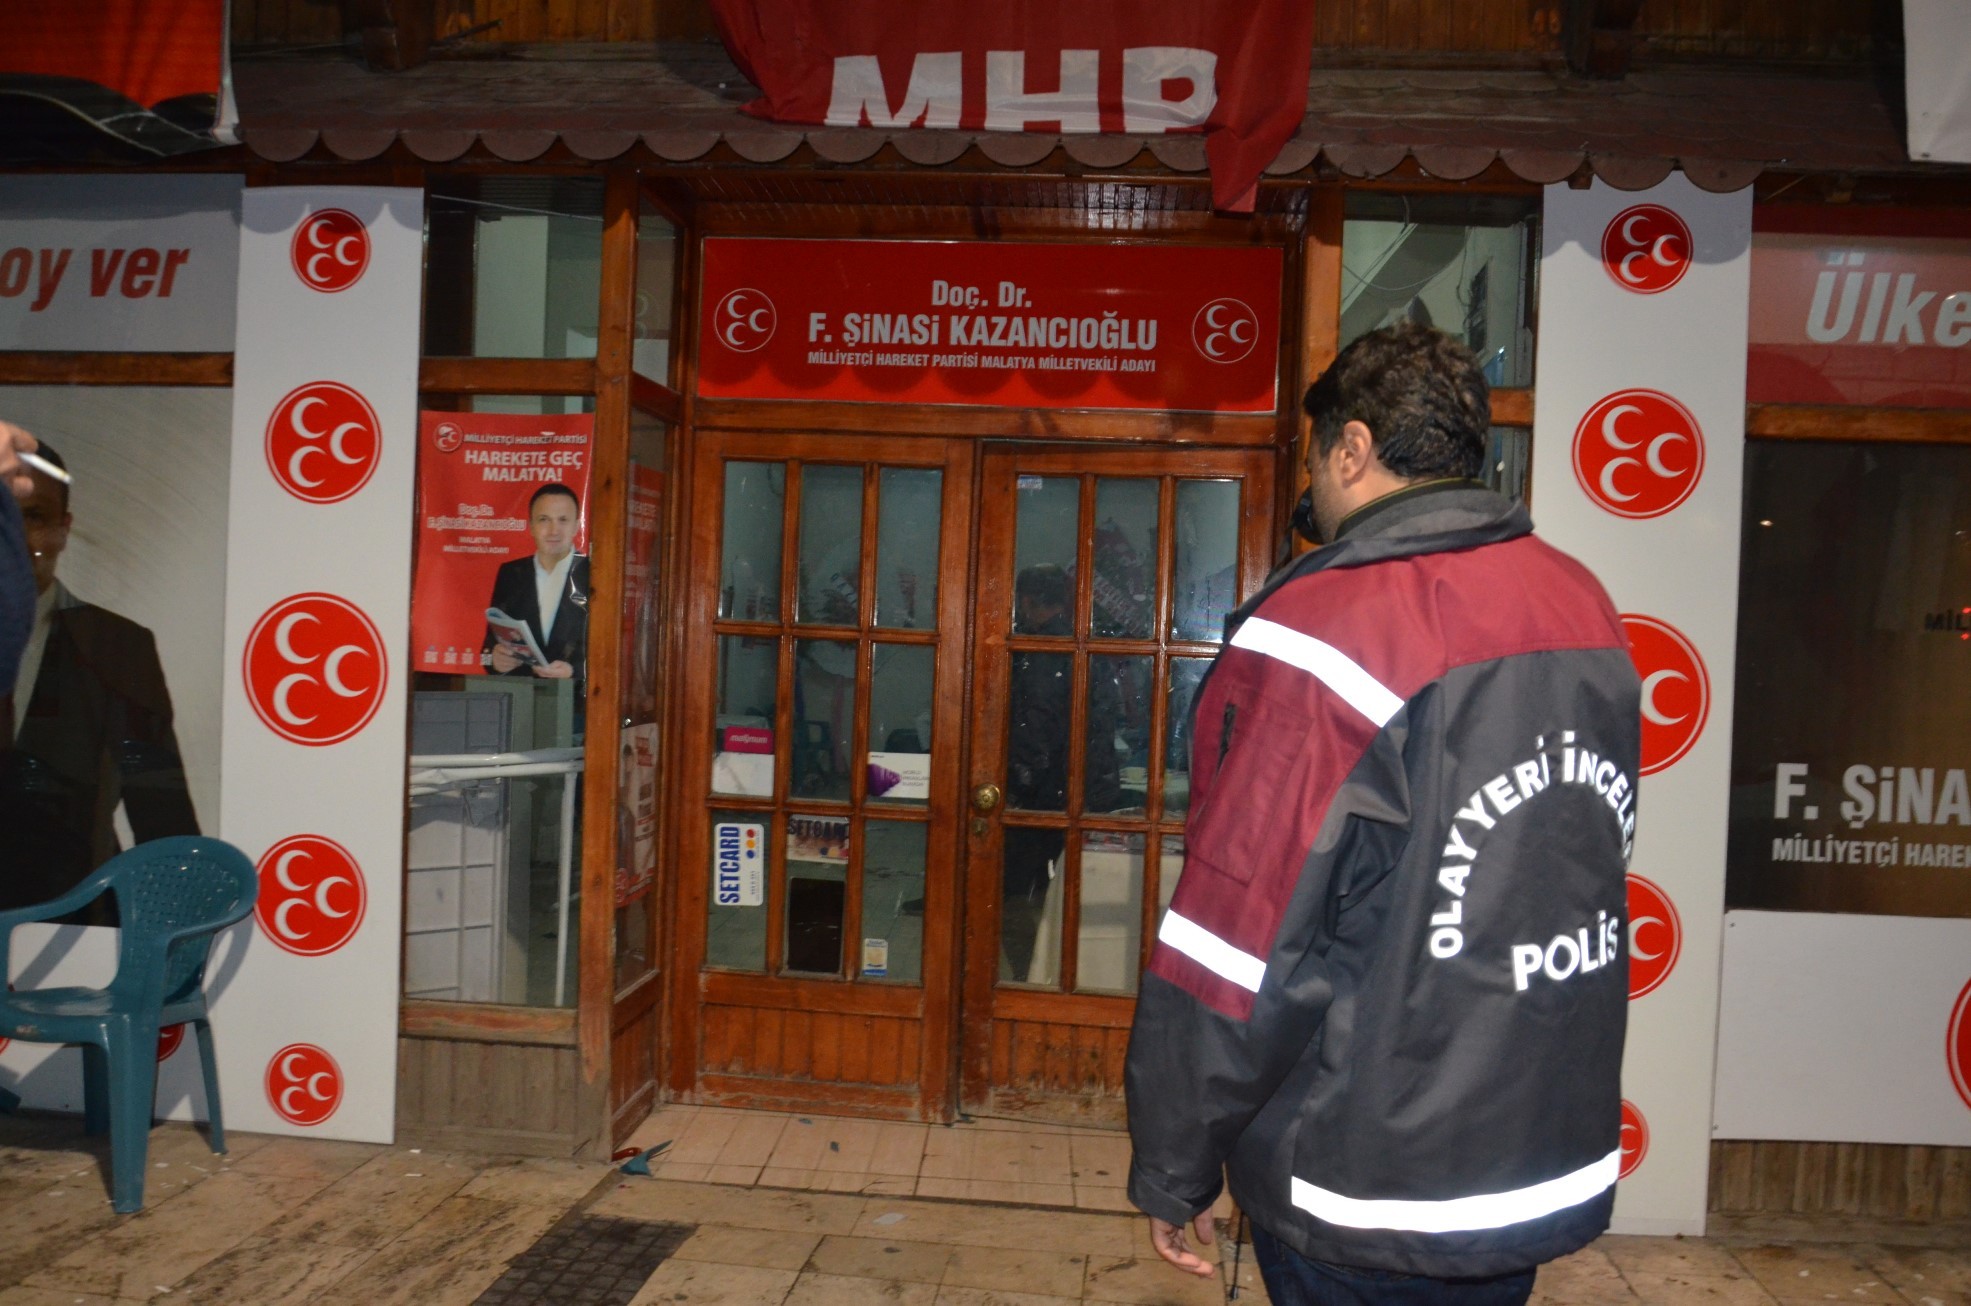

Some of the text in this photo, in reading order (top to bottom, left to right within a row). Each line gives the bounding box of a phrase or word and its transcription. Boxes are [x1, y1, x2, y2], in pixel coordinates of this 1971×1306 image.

[823, 46, 1219, 134] MHP
[0, 247, 191, 312] oy ver
[931, 279, 1033, 310] Doç. Dr.
[808, 312, 833, 343] F.
[949, 310, 1158, 351] KAZANCIOĞLU
[807, 349, 1156, 373] MİLLİYETÇİ HAREKET PARTİSİ MALATYA MİLLETVEKİLİ ADAYI
[464, 450, 583, 470] HAREKETE GEÇ
[482, 467, 563, 482] MALATYA!
[1774, 763, 1819, 820] F.
[719, 826, 741, 904] SETCARD
[1772, 833, 1899, 868] MİLLİYETÇİ
[1512, 909, 1619, 992] POLİS
